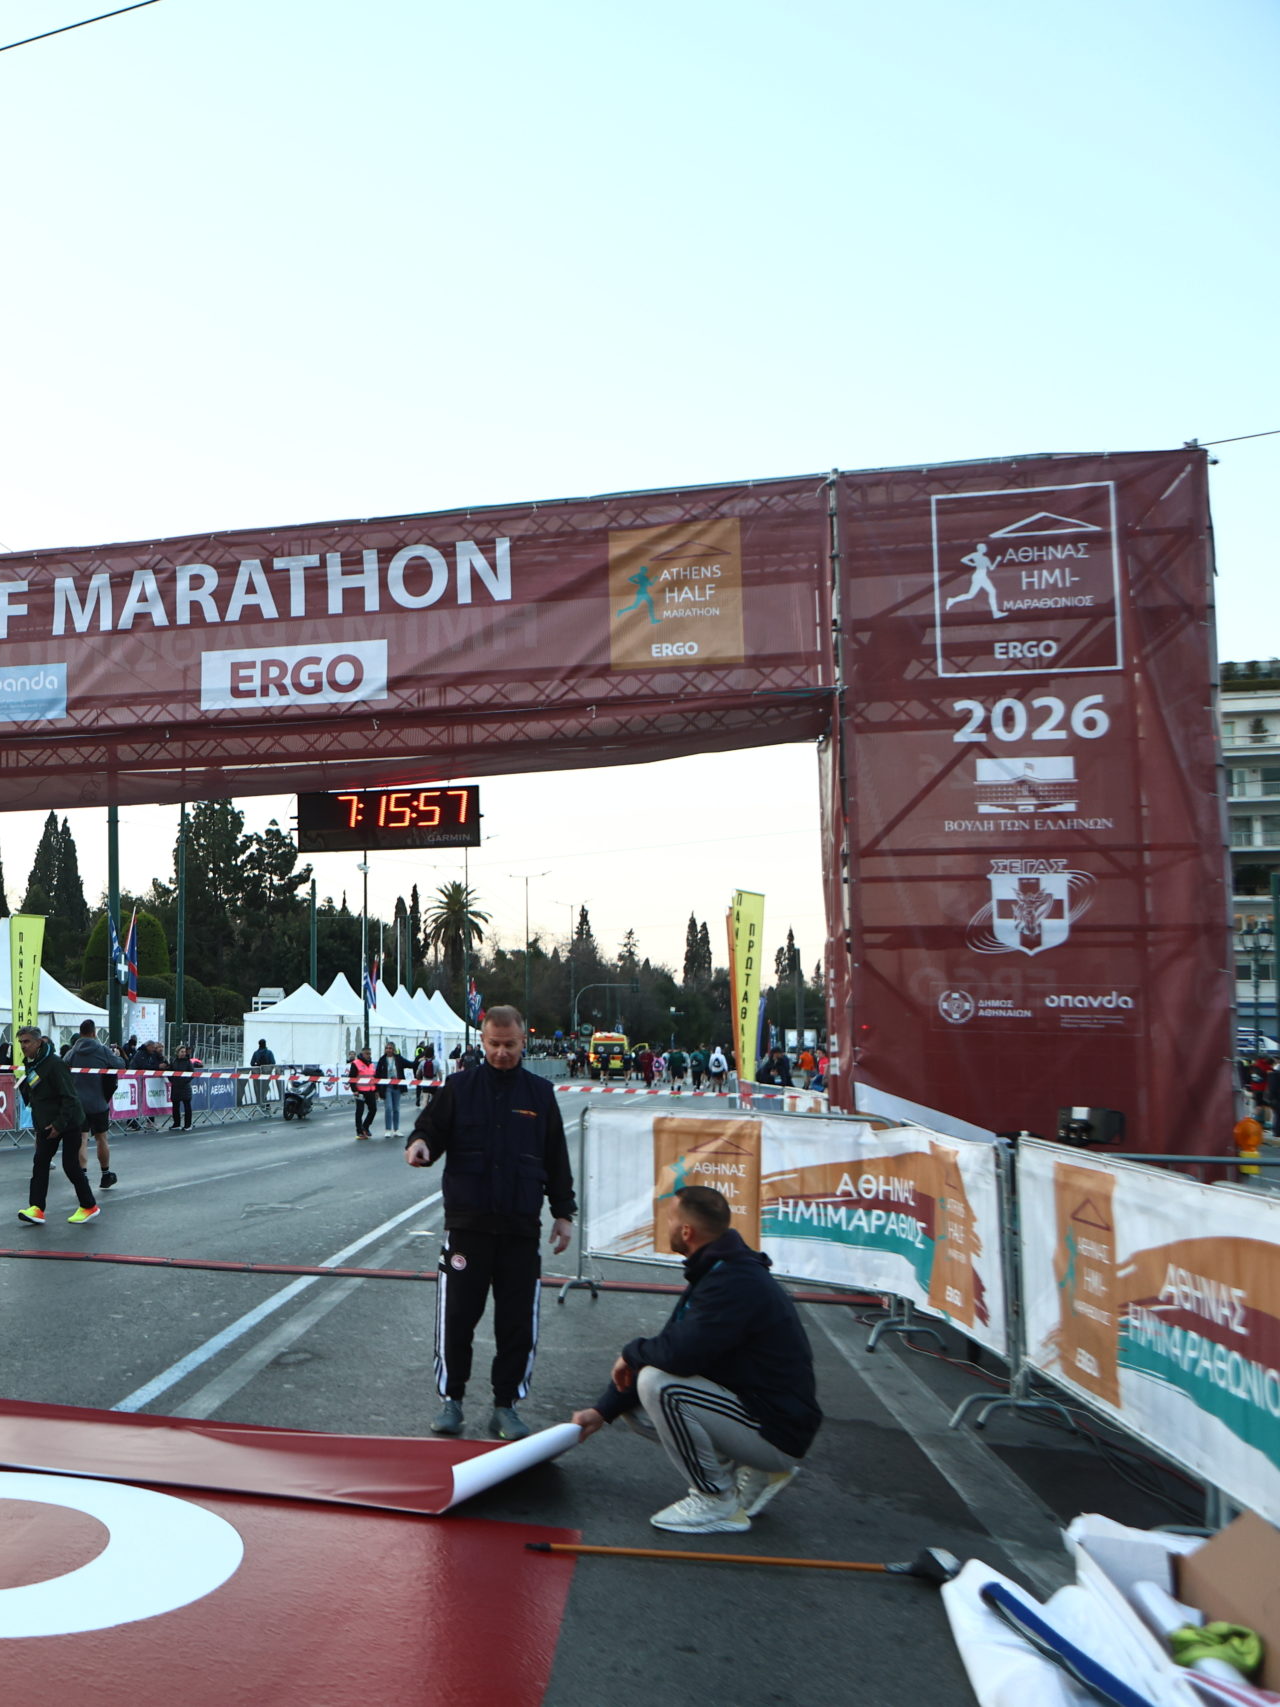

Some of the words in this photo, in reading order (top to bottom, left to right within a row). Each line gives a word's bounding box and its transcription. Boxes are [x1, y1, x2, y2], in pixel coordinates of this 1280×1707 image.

[1003, 543, 1089, 563] ΑΘΗΝΑΣ
[659, 565, 721, 582] ATHENS
[51, 537, 512, 635] MARATHON
[665, 584, 716, 604] HALF
[1003, 595, 1095, 611] ΜΑΡΑΘΩΝΙΟΣ
[663, 607, 720, 619] MARATHON
[651, 641, 698, 657] ERGO
[994, 639, 1058, 660] ERGO
[230, 653, 365, 700] ERGO
[953, 694, 1111, 743] 2026
[337, 790, 468, 828] 7:15:57
[944, 819, 994, 832] ΒΟΥΛΗ
[998, 819, 1030, 831] ΤΩΝ
[1034, 817, 1113, 831] ΕΛΛΗΝΩΝ
[428, 833, 471, 842] GARMIN
[990, 859, 1067, 874] ΣΕΓΑΣ
[978, 999, 1013, 1008] ΔΗΜΟΣ
[978, 1008, 1032, 1017] ΑΘΗΝΑΙΩΝ
[693, 1161, 747, 1177] ΑΘΗΝΑΣ
[836, 1172, 916, 1207] ΑΘΗΝΑΣ
[1158, 1263, 1250, 1336] ΑΘΗΝΑΣ
